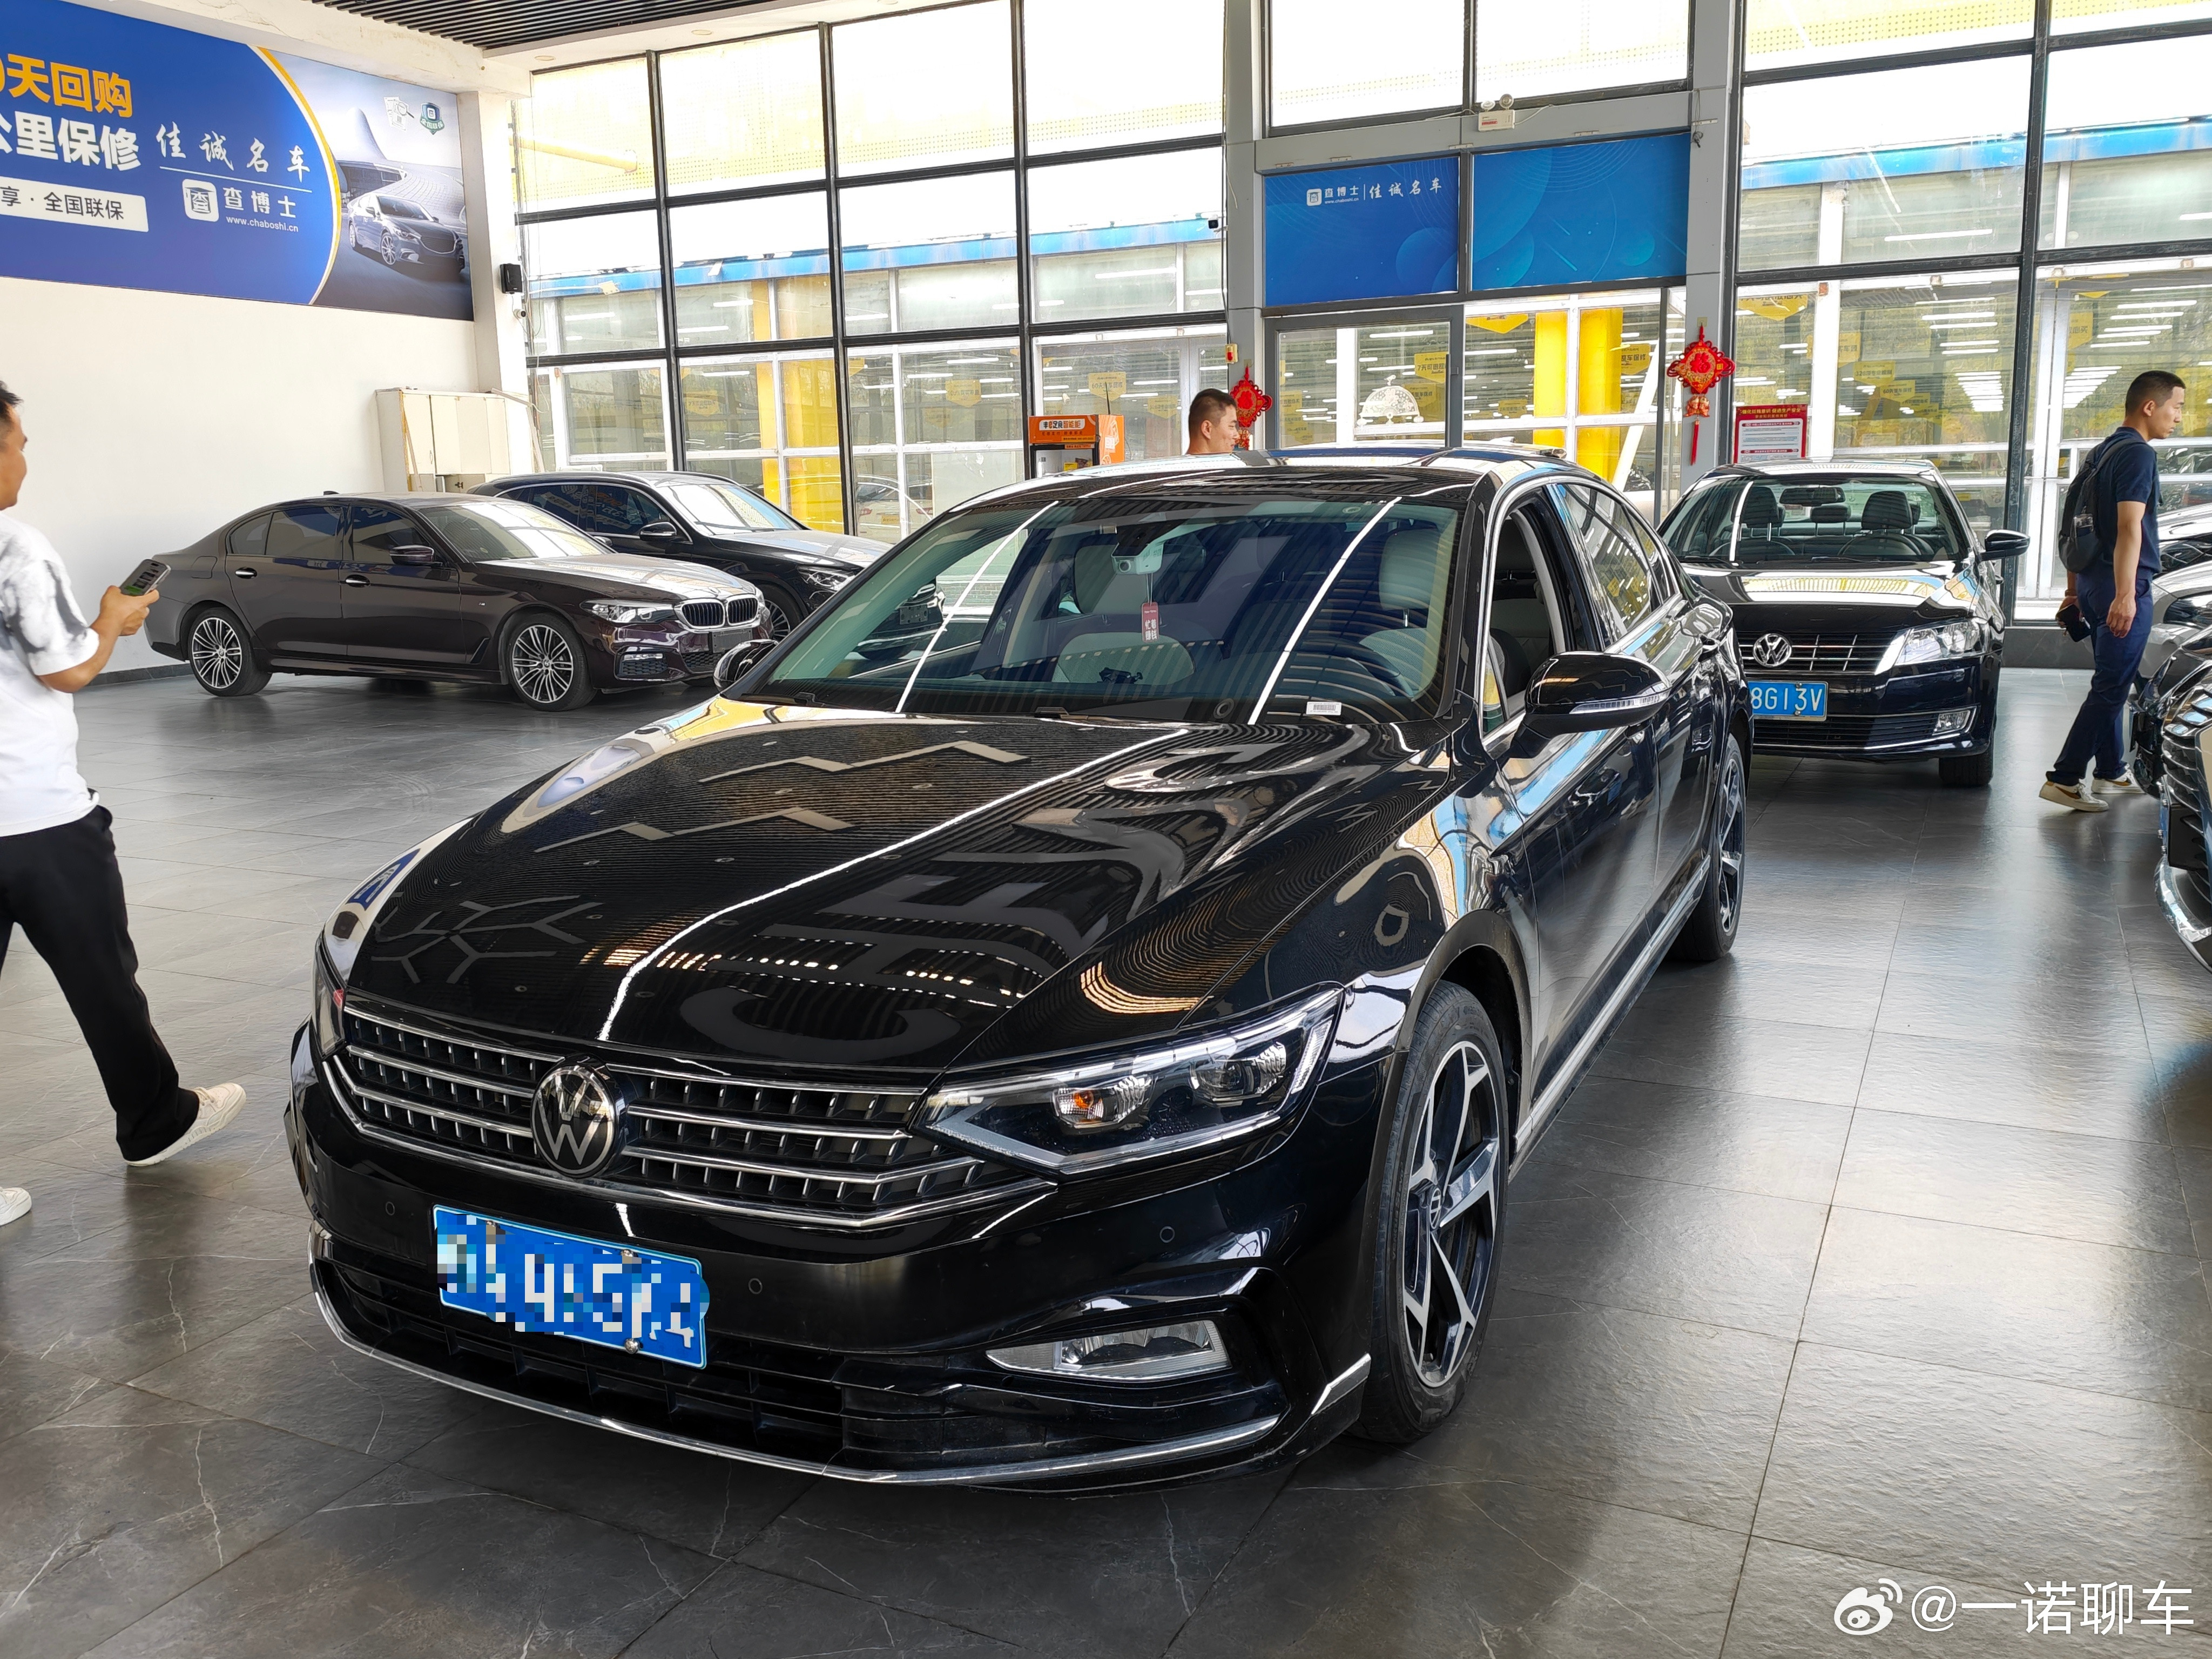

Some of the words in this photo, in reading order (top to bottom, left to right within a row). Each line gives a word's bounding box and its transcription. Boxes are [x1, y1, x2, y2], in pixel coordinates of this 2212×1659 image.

[156, 121, 311, 183] 佳诚名车
[1324, 185, 1359, 198] 查博士
[1369, 177, 1442, 199] 佳诚名车
[222, 187, 296, 218] 查博士
[226, 216, 299, 232] www.chaboshi.cn
[1751, 687, 1823, 711] 8G13V
